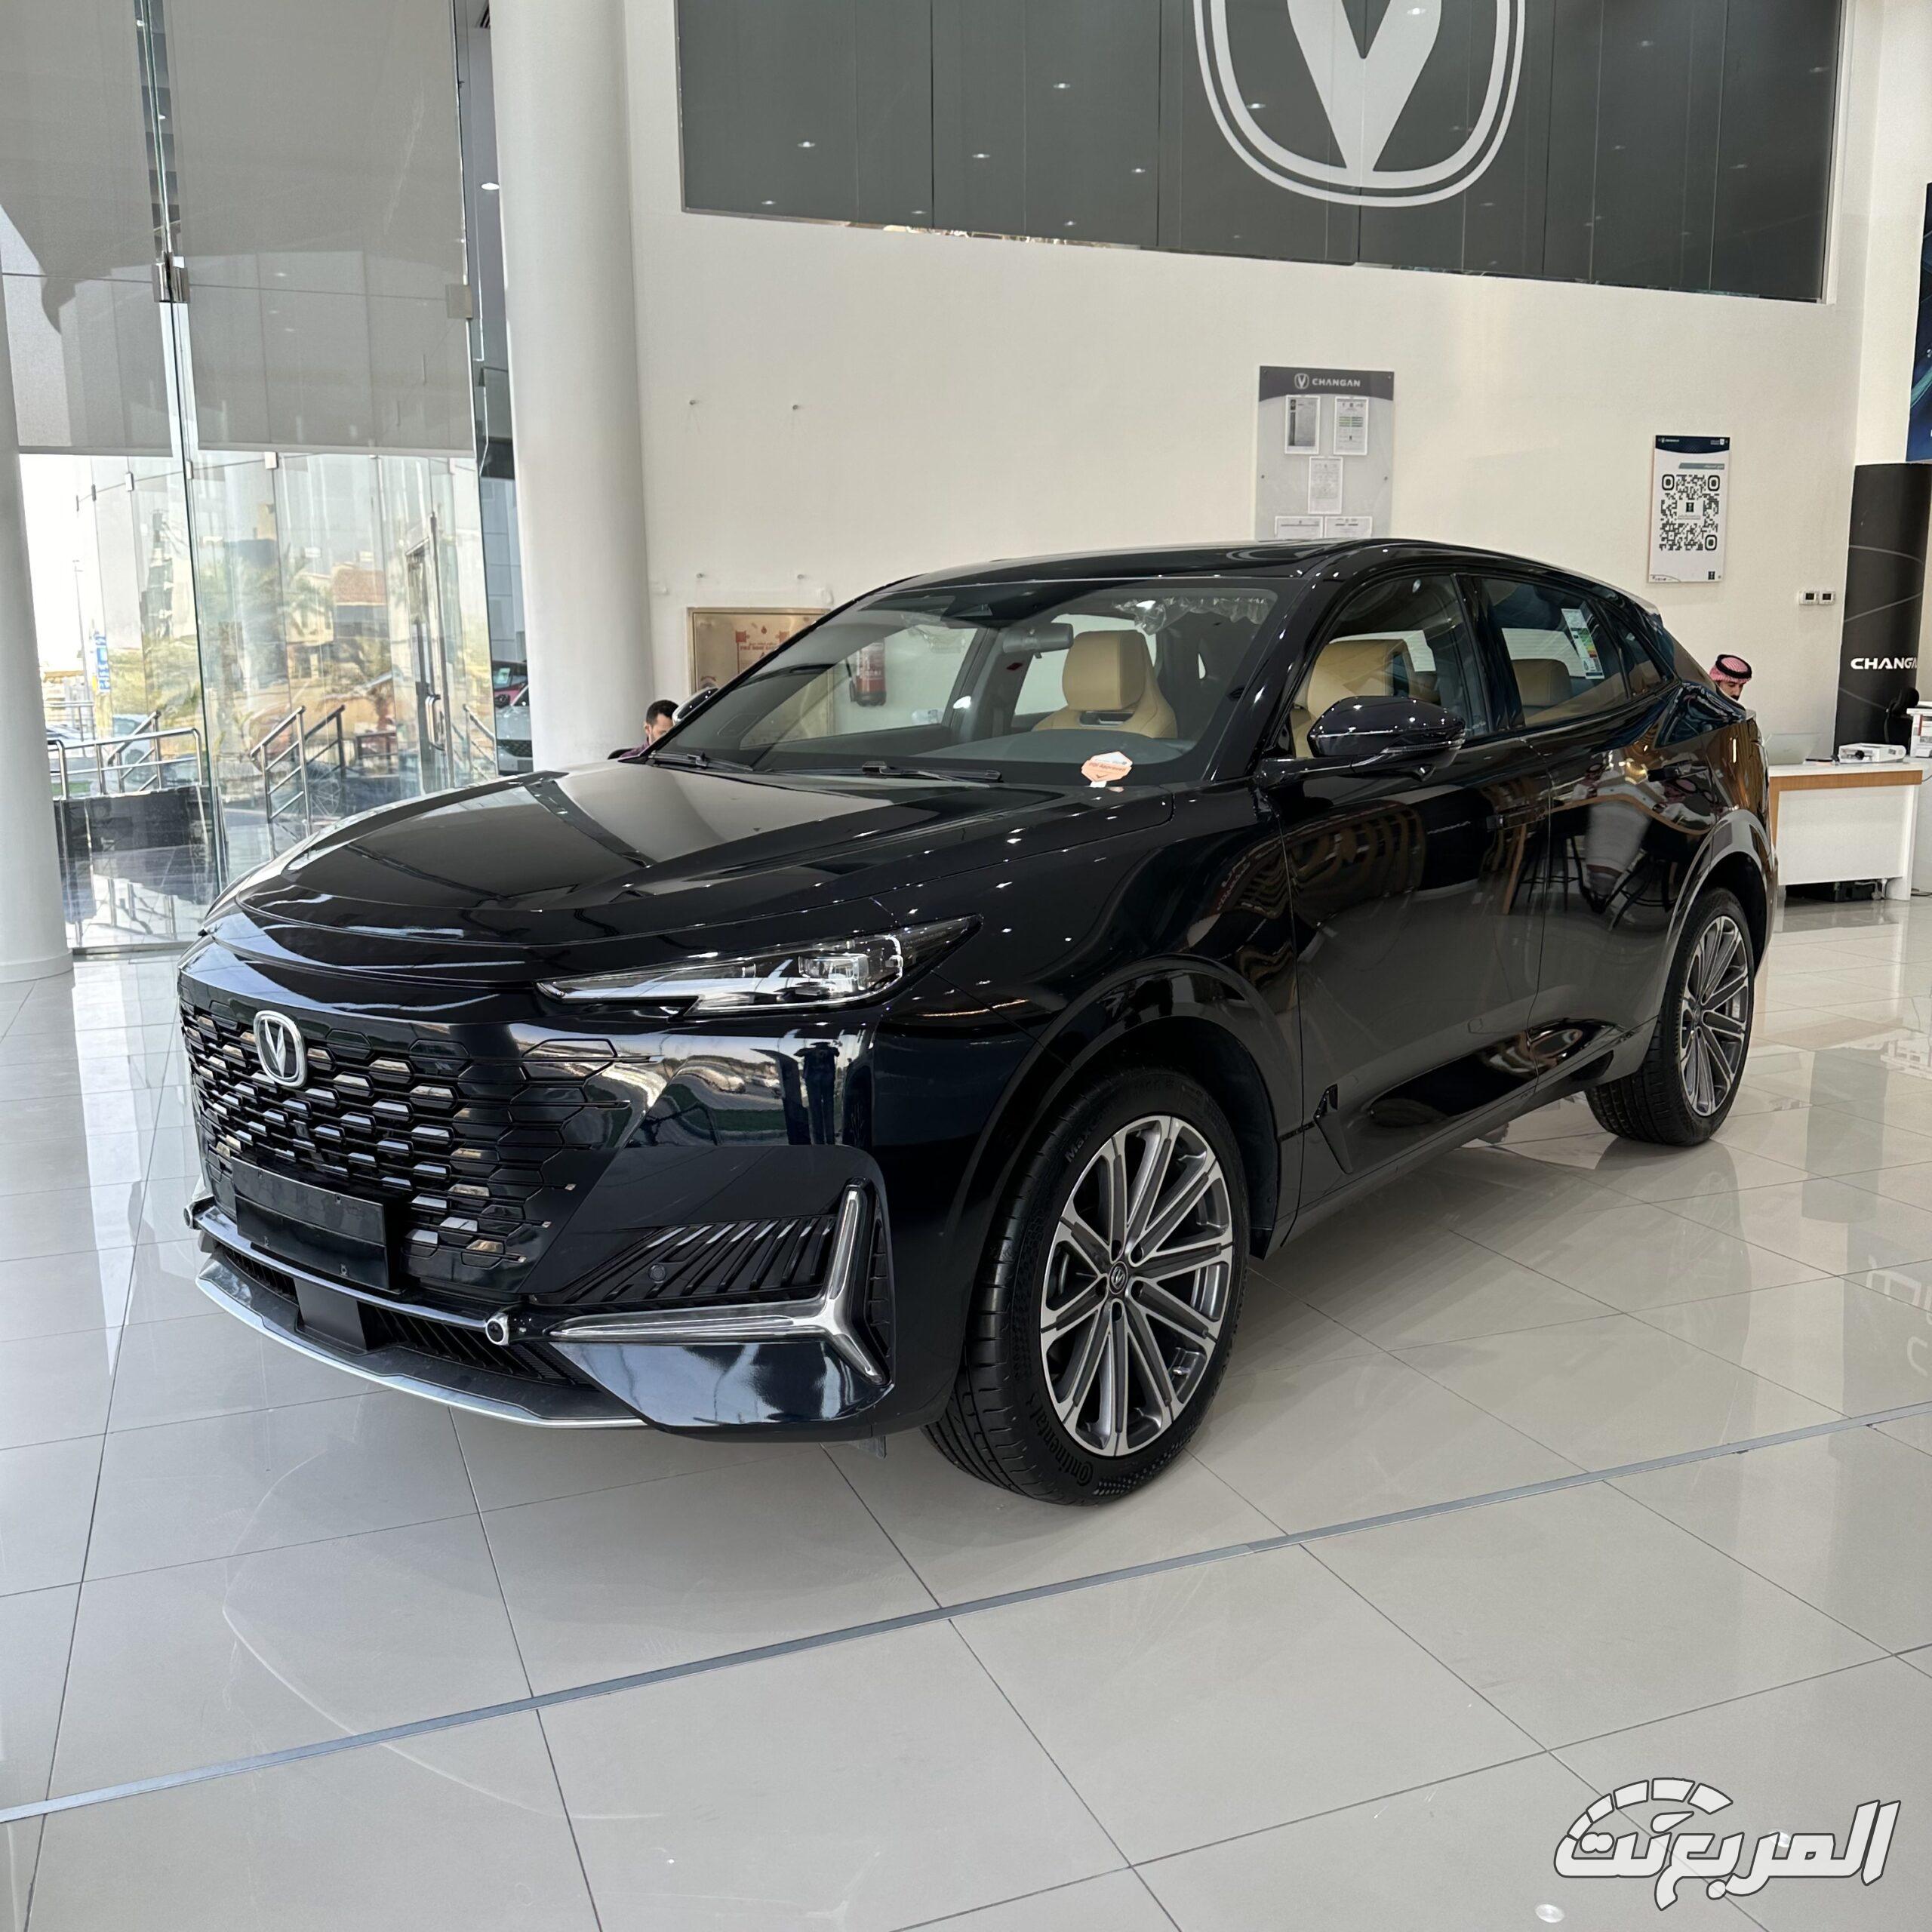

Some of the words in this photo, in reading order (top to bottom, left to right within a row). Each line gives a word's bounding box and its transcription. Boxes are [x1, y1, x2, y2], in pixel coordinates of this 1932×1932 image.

[1312, 377, 1361, 387] CHANGAN
[1850, 657, 1918, 669] CHANGA
[1029, 1406, 1094, 1487] Continental
